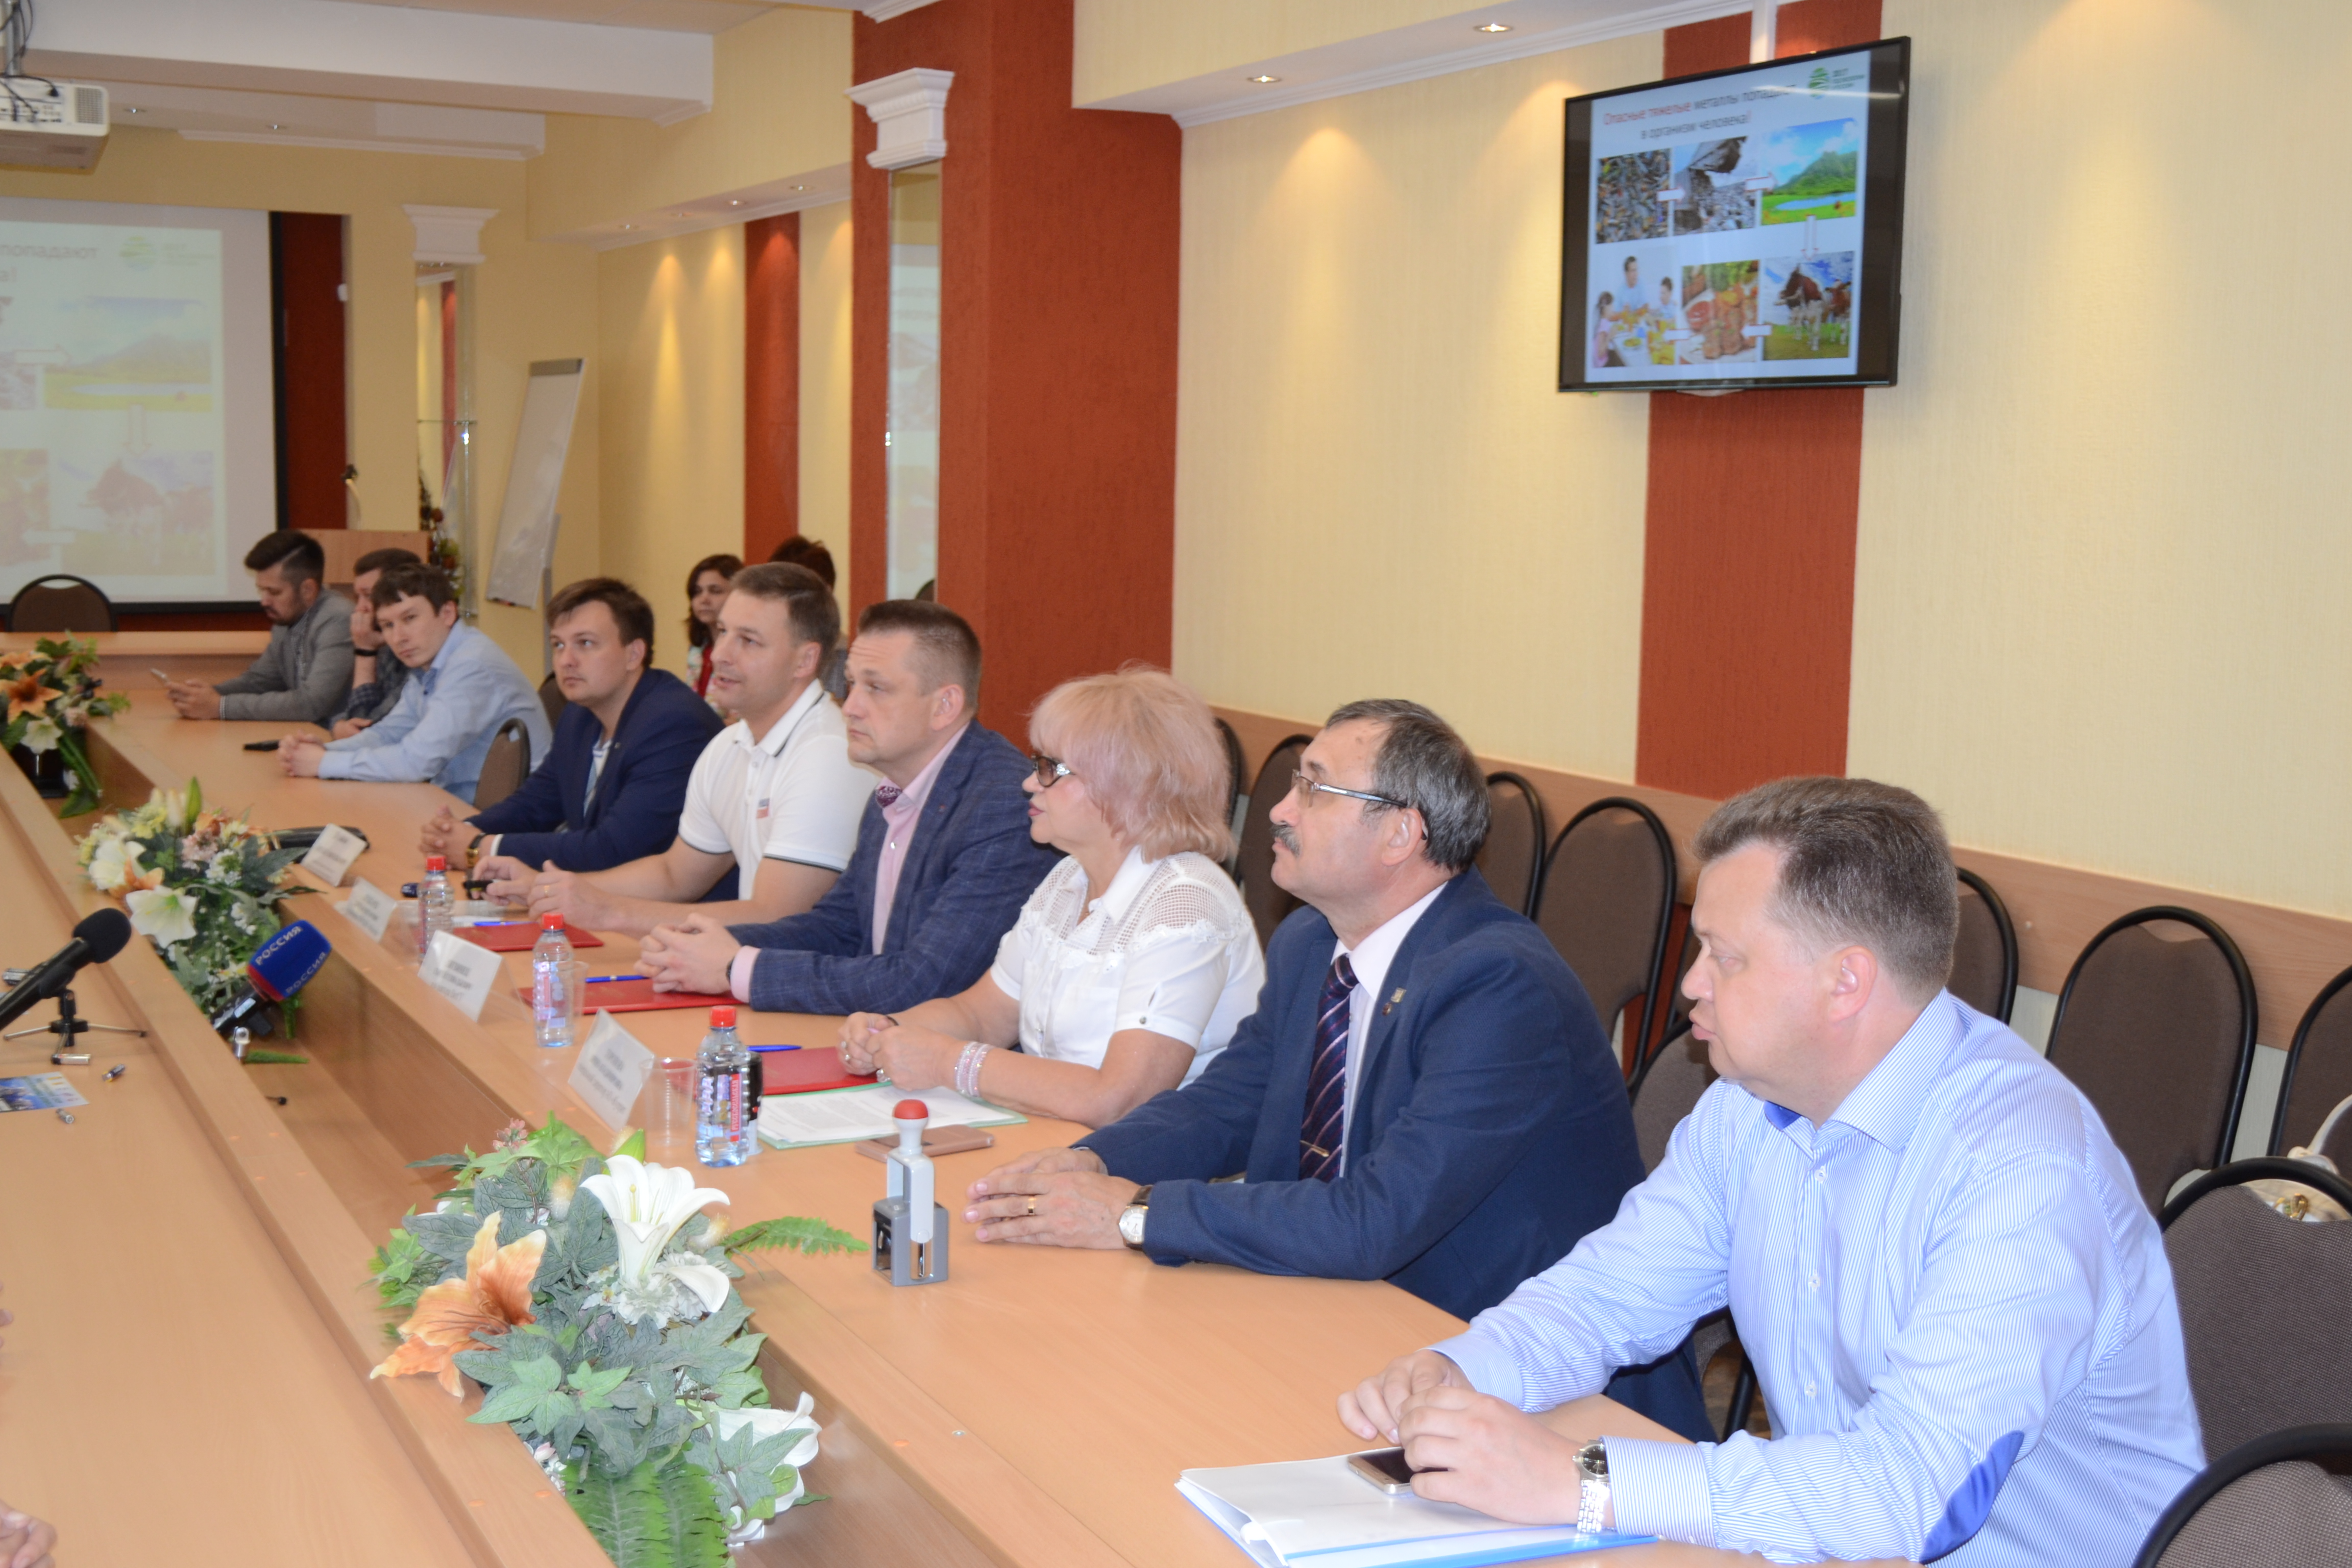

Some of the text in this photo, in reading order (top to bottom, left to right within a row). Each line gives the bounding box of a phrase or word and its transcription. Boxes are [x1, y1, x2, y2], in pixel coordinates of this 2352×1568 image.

[1604, 84, 1797, 125] Опасные тяжелые металлы попада
[1649, 122, 1696, 138] организм
[255, 926, 304, 966] РОССИЯ
[286, 951, 327, 993] РОССИЯ
